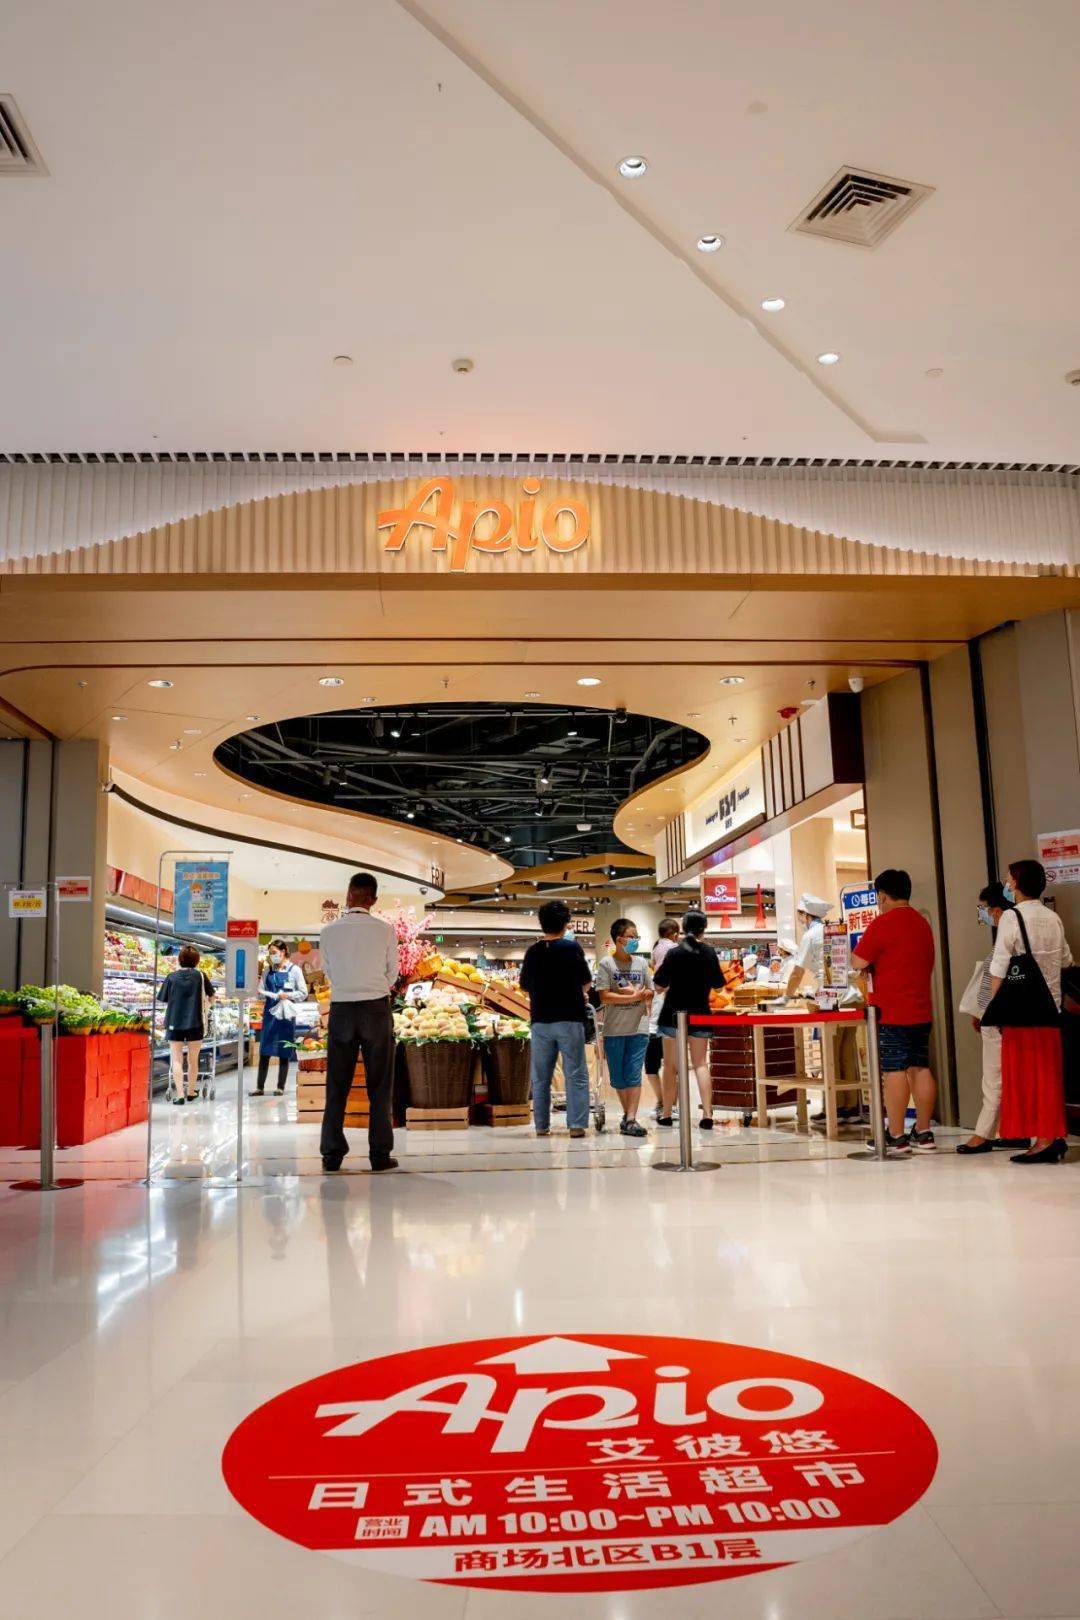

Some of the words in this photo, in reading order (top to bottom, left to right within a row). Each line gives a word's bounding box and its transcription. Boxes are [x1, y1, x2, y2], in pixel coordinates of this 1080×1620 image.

[378, 477, 590, 572] Apio
[315, 1365, 825, 1453] Apio
[587, 1430, 840, 1464] 艾彼悠
[308, 1461, 867, 1510] 日式生活超市
[420, 1513, 487, 1538] AM
[719, 1498, 842, 1524] 10:00
[453, 1538, 764, 1573] 商场北区B1层
